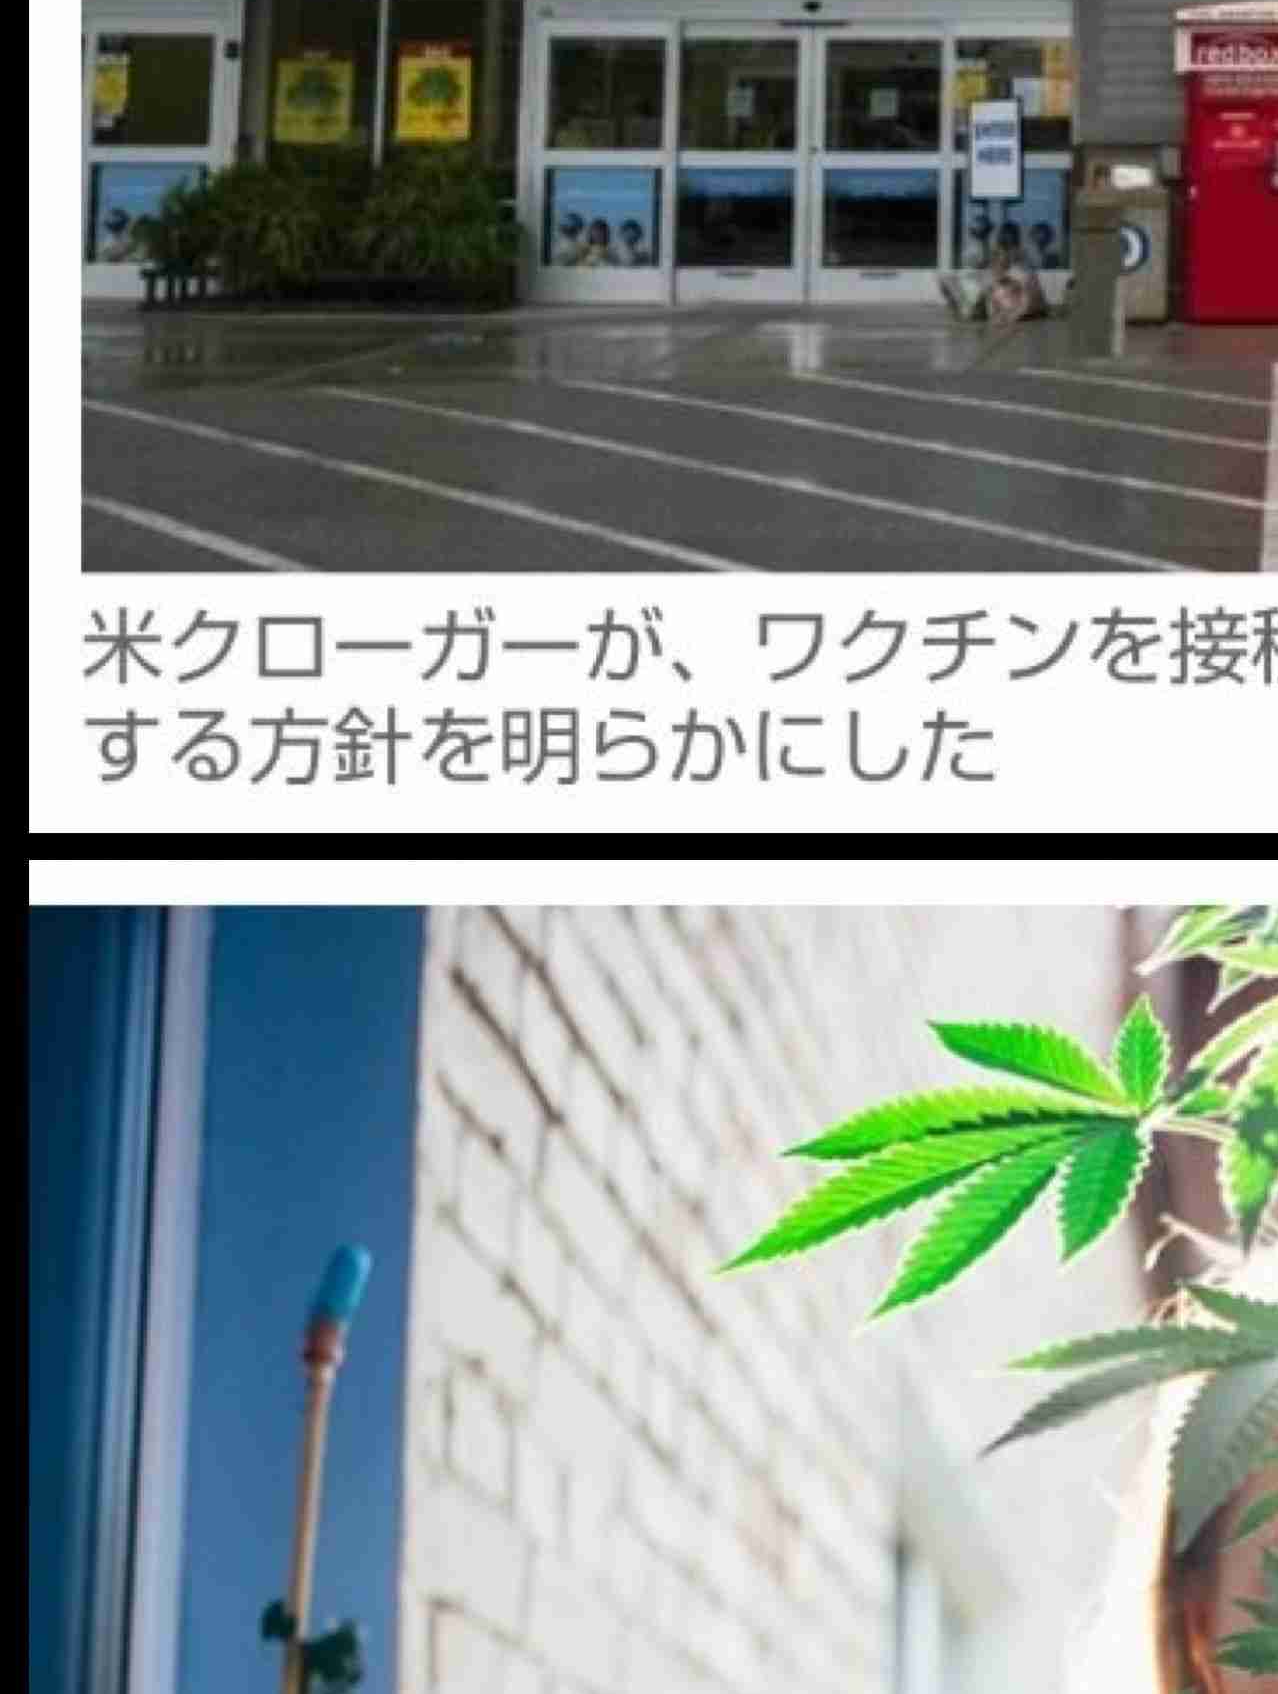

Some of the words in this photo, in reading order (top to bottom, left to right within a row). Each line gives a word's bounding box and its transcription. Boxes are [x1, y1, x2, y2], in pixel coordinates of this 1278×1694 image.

[84, 706, 995, 786] する方針を明らかにした
